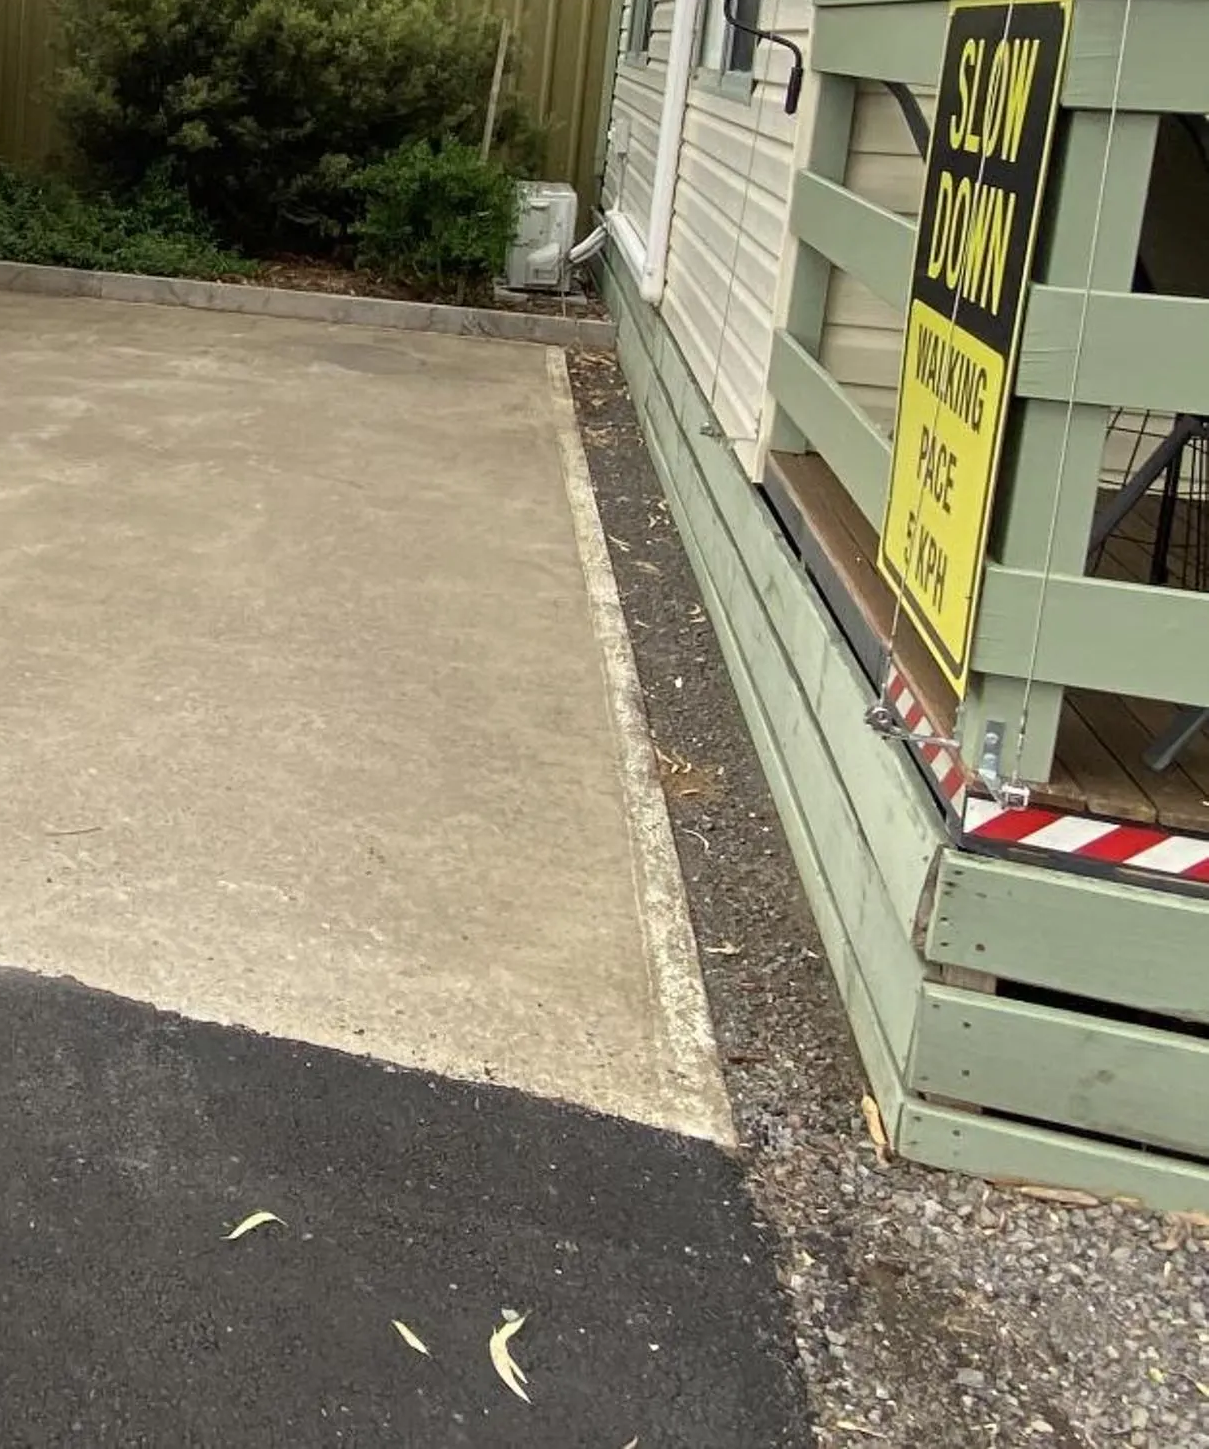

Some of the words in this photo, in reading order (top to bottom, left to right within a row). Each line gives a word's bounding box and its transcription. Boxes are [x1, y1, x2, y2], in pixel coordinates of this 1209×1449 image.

[949, 38, 1040, 163] SLOW
[927, 170, 1017, 316] DOWN
[915, 323, 988, 435] WALKING
[916, 425, 958, 514] PACE
